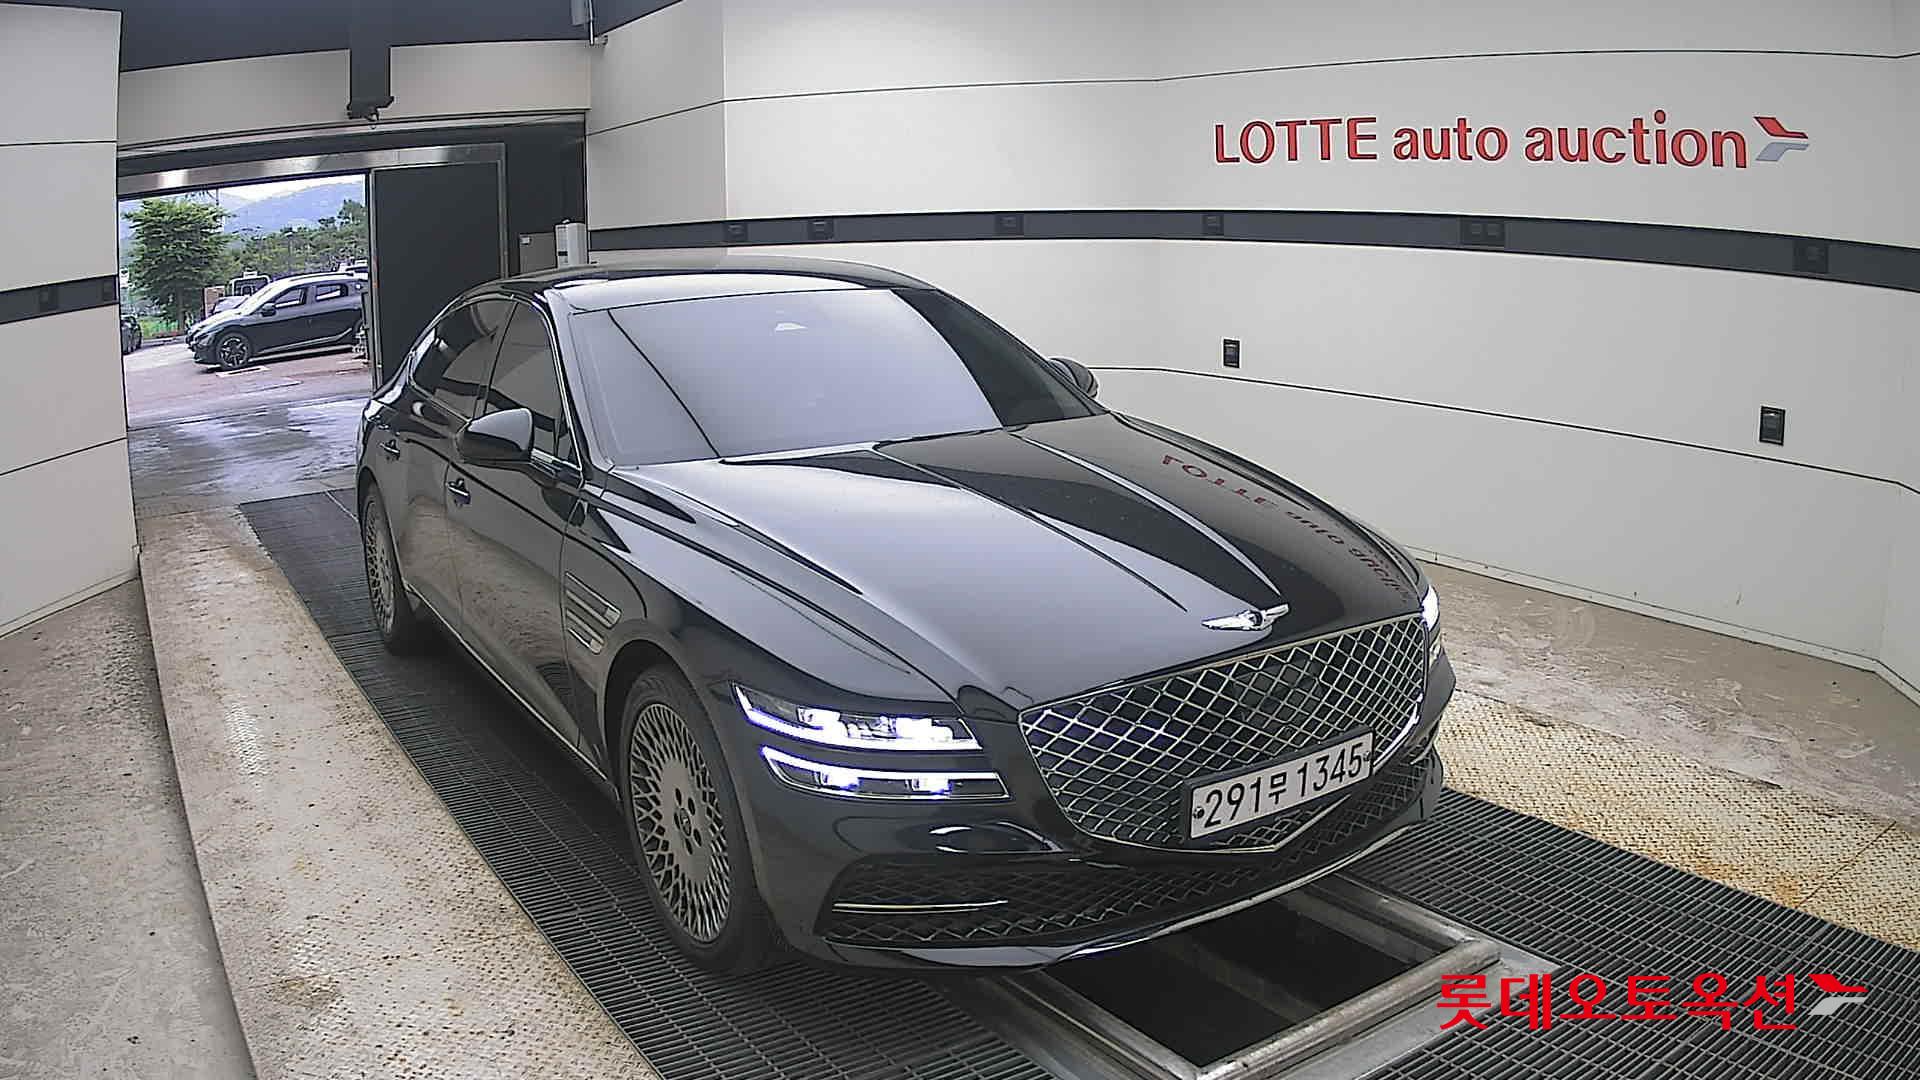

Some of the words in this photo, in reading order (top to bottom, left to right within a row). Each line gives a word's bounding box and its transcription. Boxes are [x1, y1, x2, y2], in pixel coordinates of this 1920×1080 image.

[1214, 117, 1377, 163] LOTTE
[1393, 117, 1509, 162] auto
[1524, 110, 1748, 168] auction
[1204, 772, 1287, 828] 291무
[1297, 742, 1364, 798] 1345
